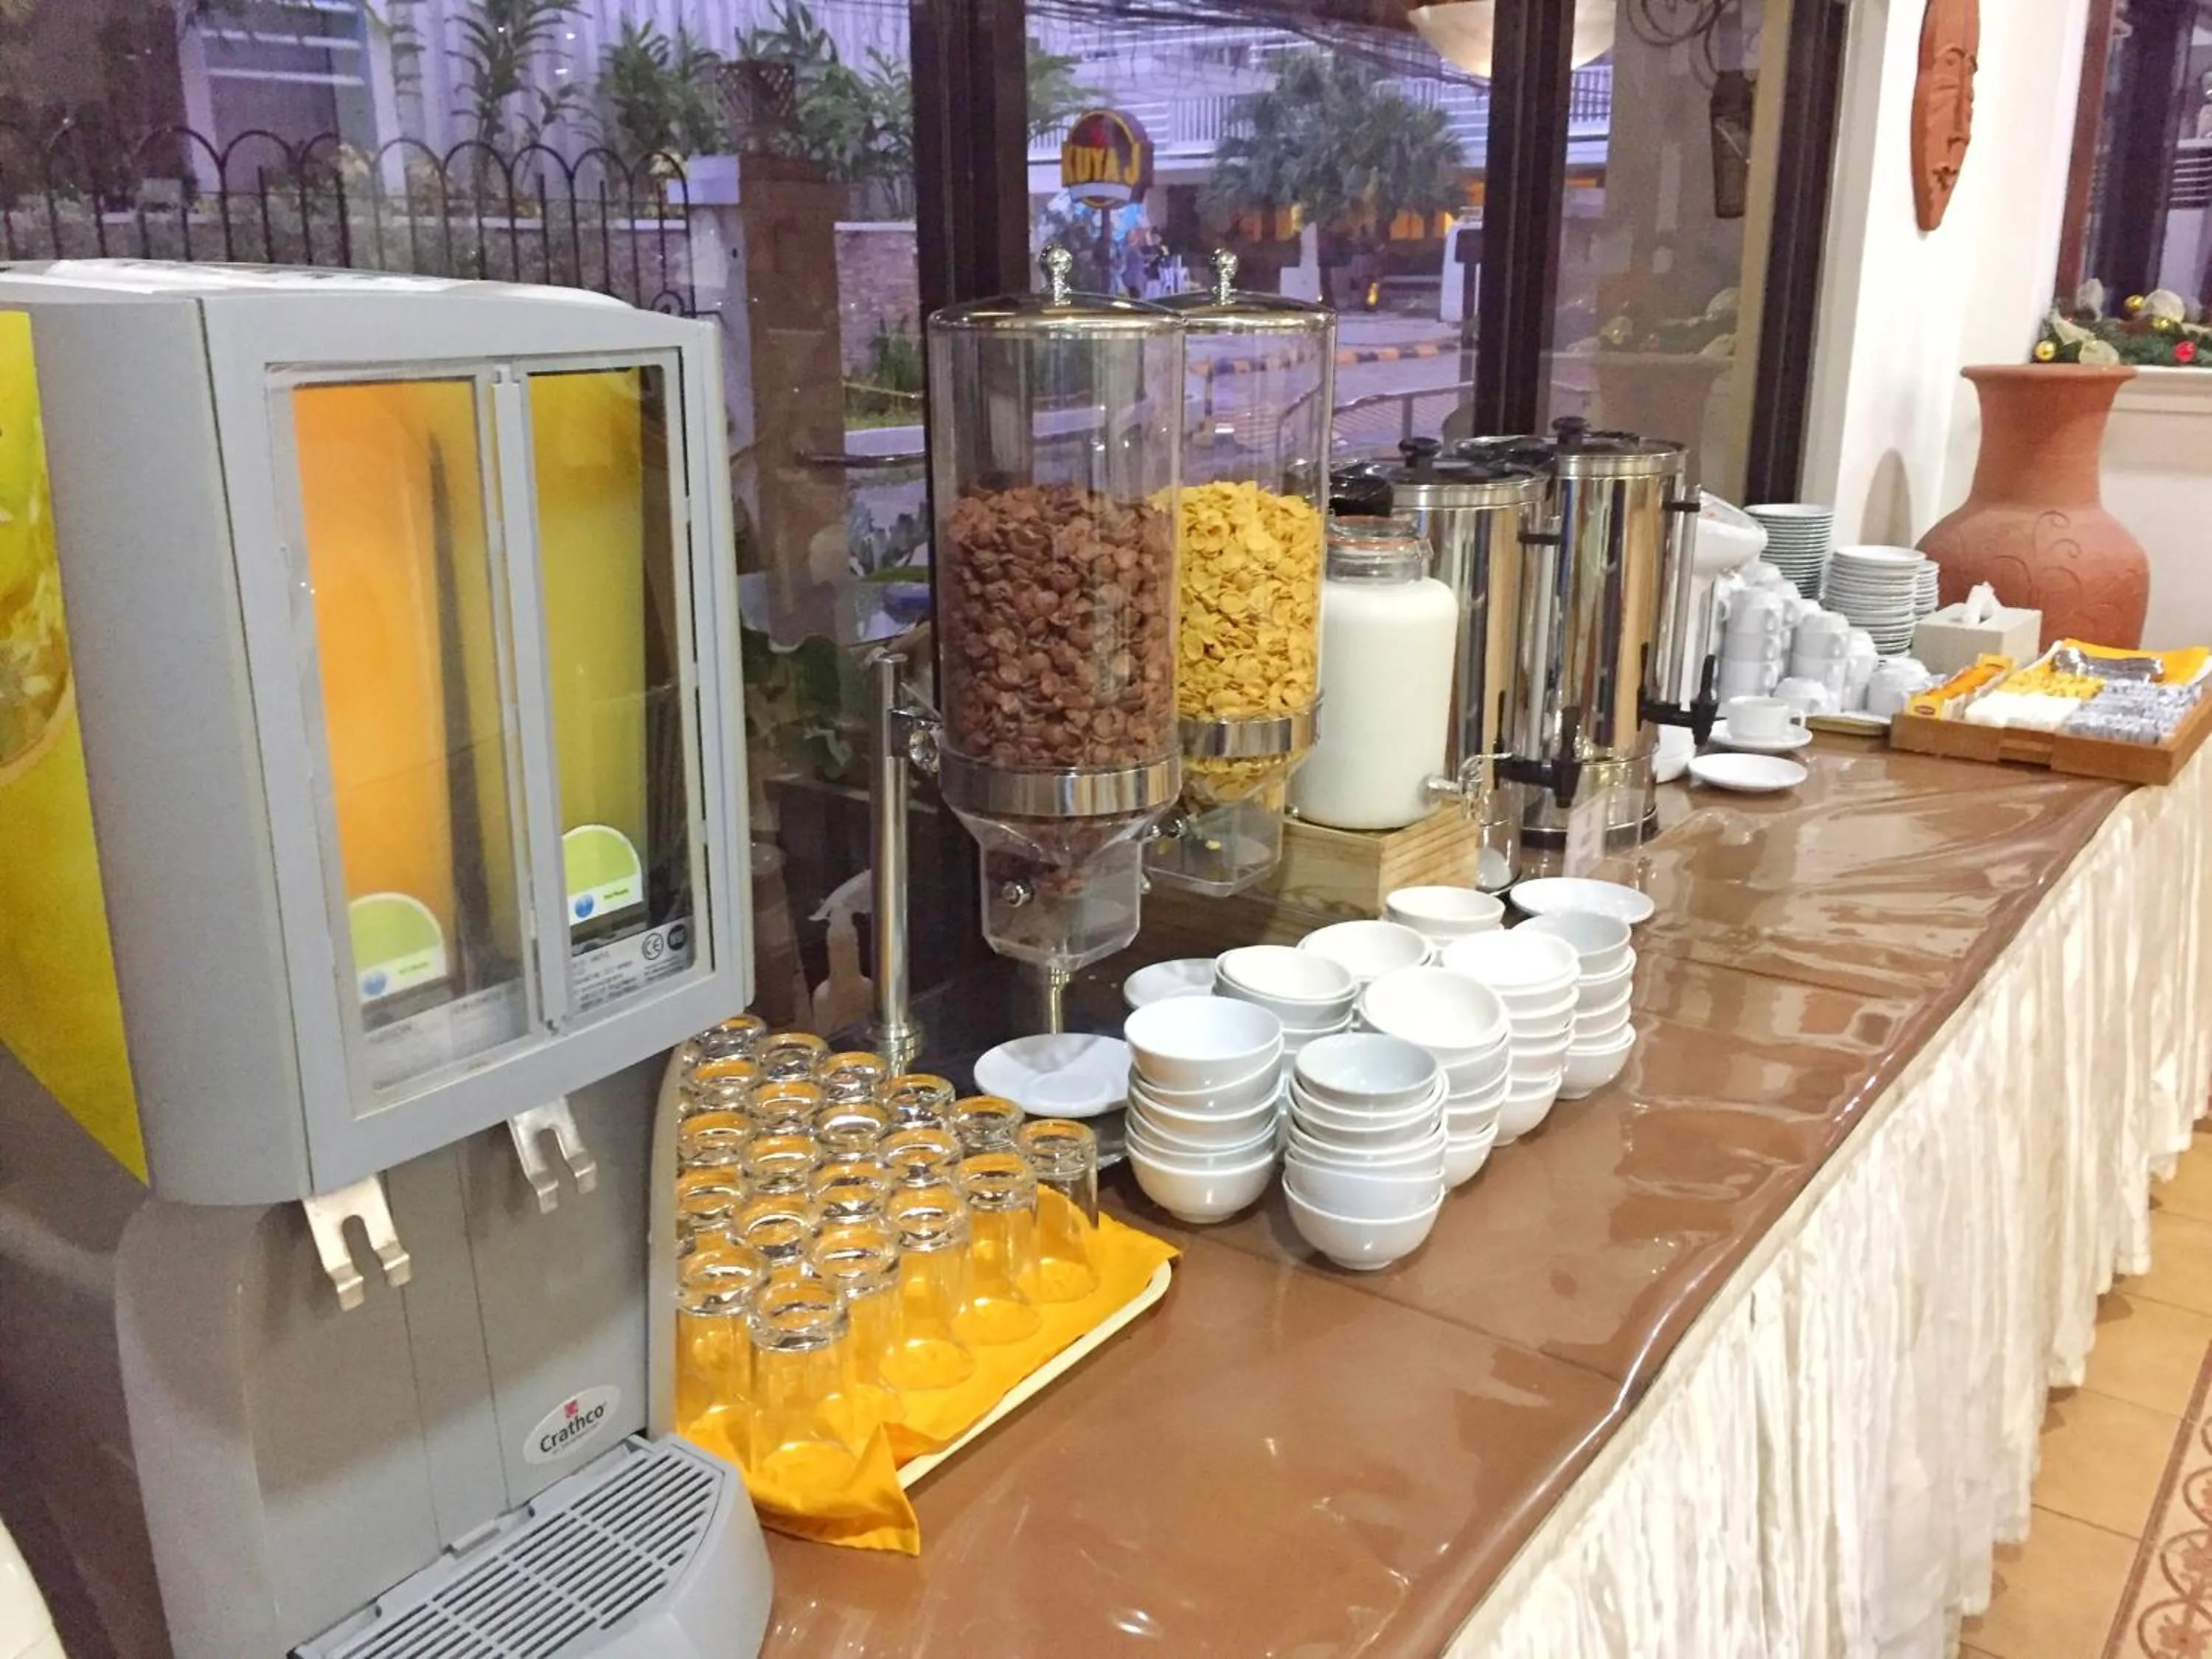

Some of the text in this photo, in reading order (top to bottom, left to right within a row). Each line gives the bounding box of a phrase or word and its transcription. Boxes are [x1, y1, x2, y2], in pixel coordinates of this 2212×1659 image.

[1062, 142, 1141, 186] KUYA J
[540, 1405, 605, 1453] Crathco
